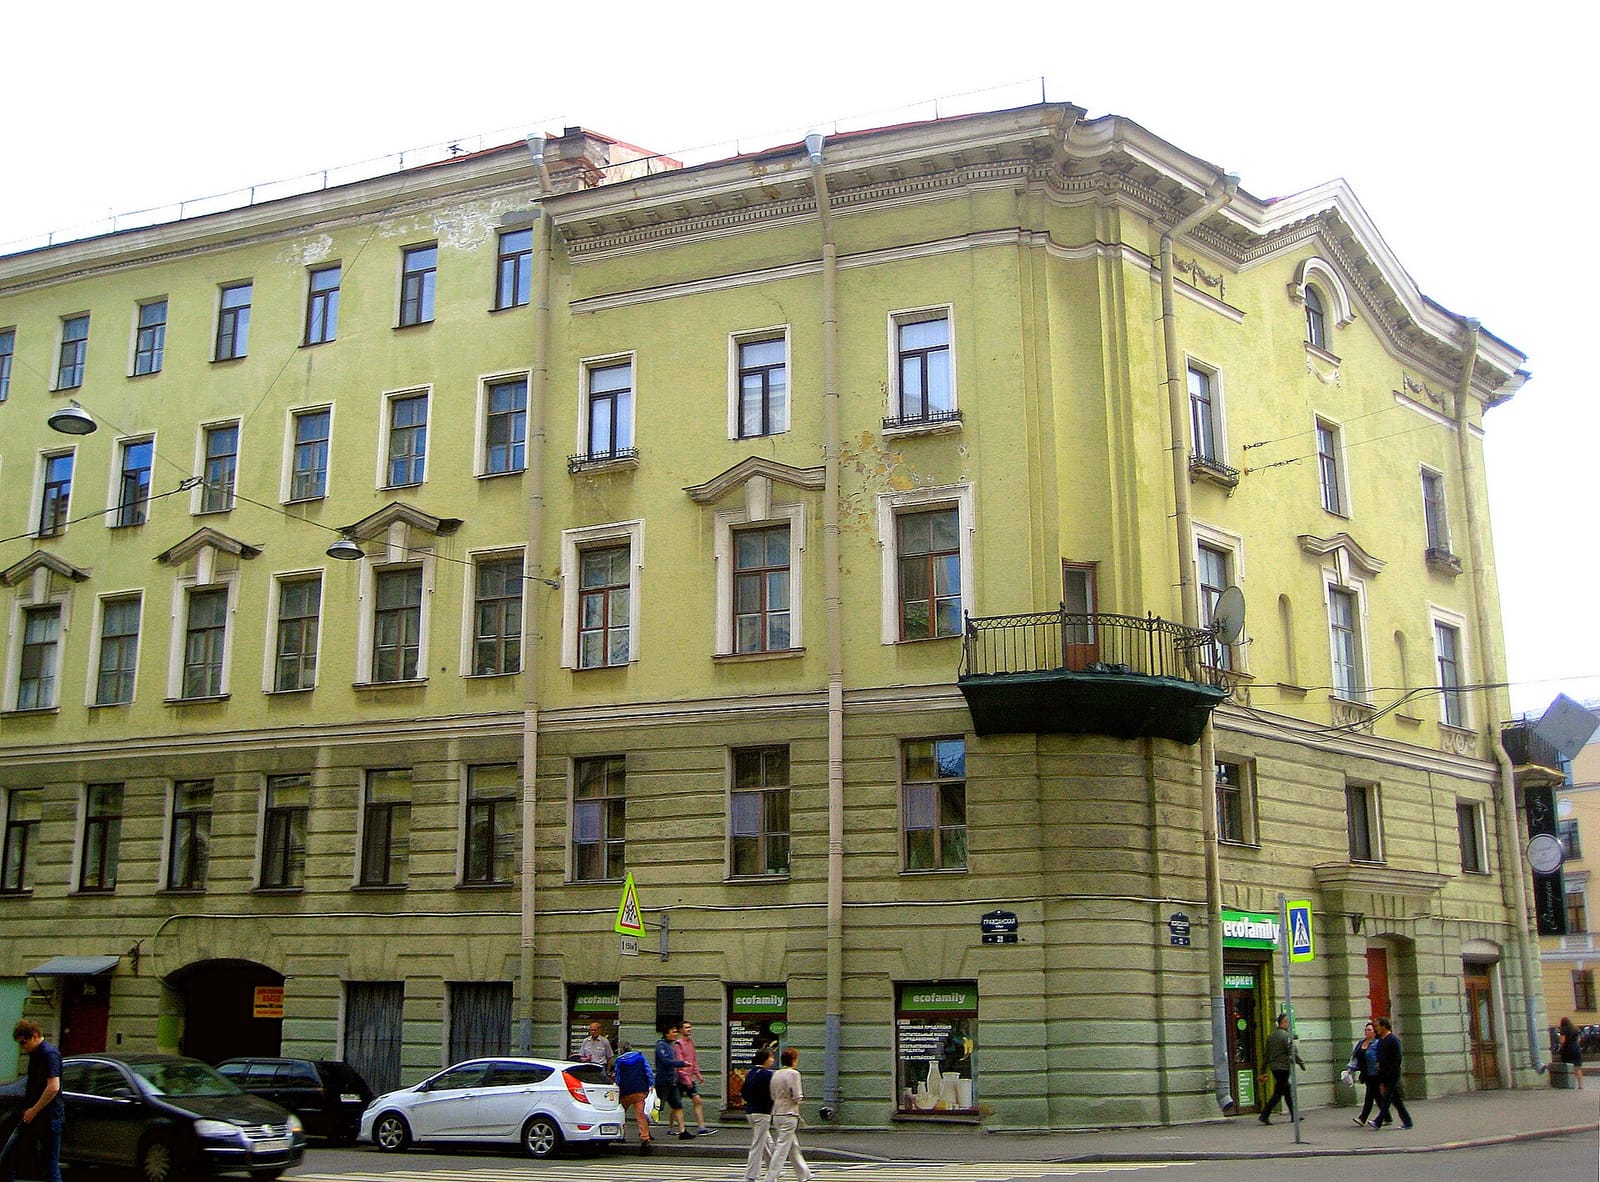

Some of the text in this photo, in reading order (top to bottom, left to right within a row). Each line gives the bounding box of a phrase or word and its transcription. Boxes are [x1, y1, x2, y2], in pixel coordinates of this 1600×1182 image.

[1223, 917, 1280, 944] ecofamily
[1225, 976, 1254, 988] маркет
[735, 994, 784, 1007] ecofamily
[912, 992, 966, 1004] ecofamily
